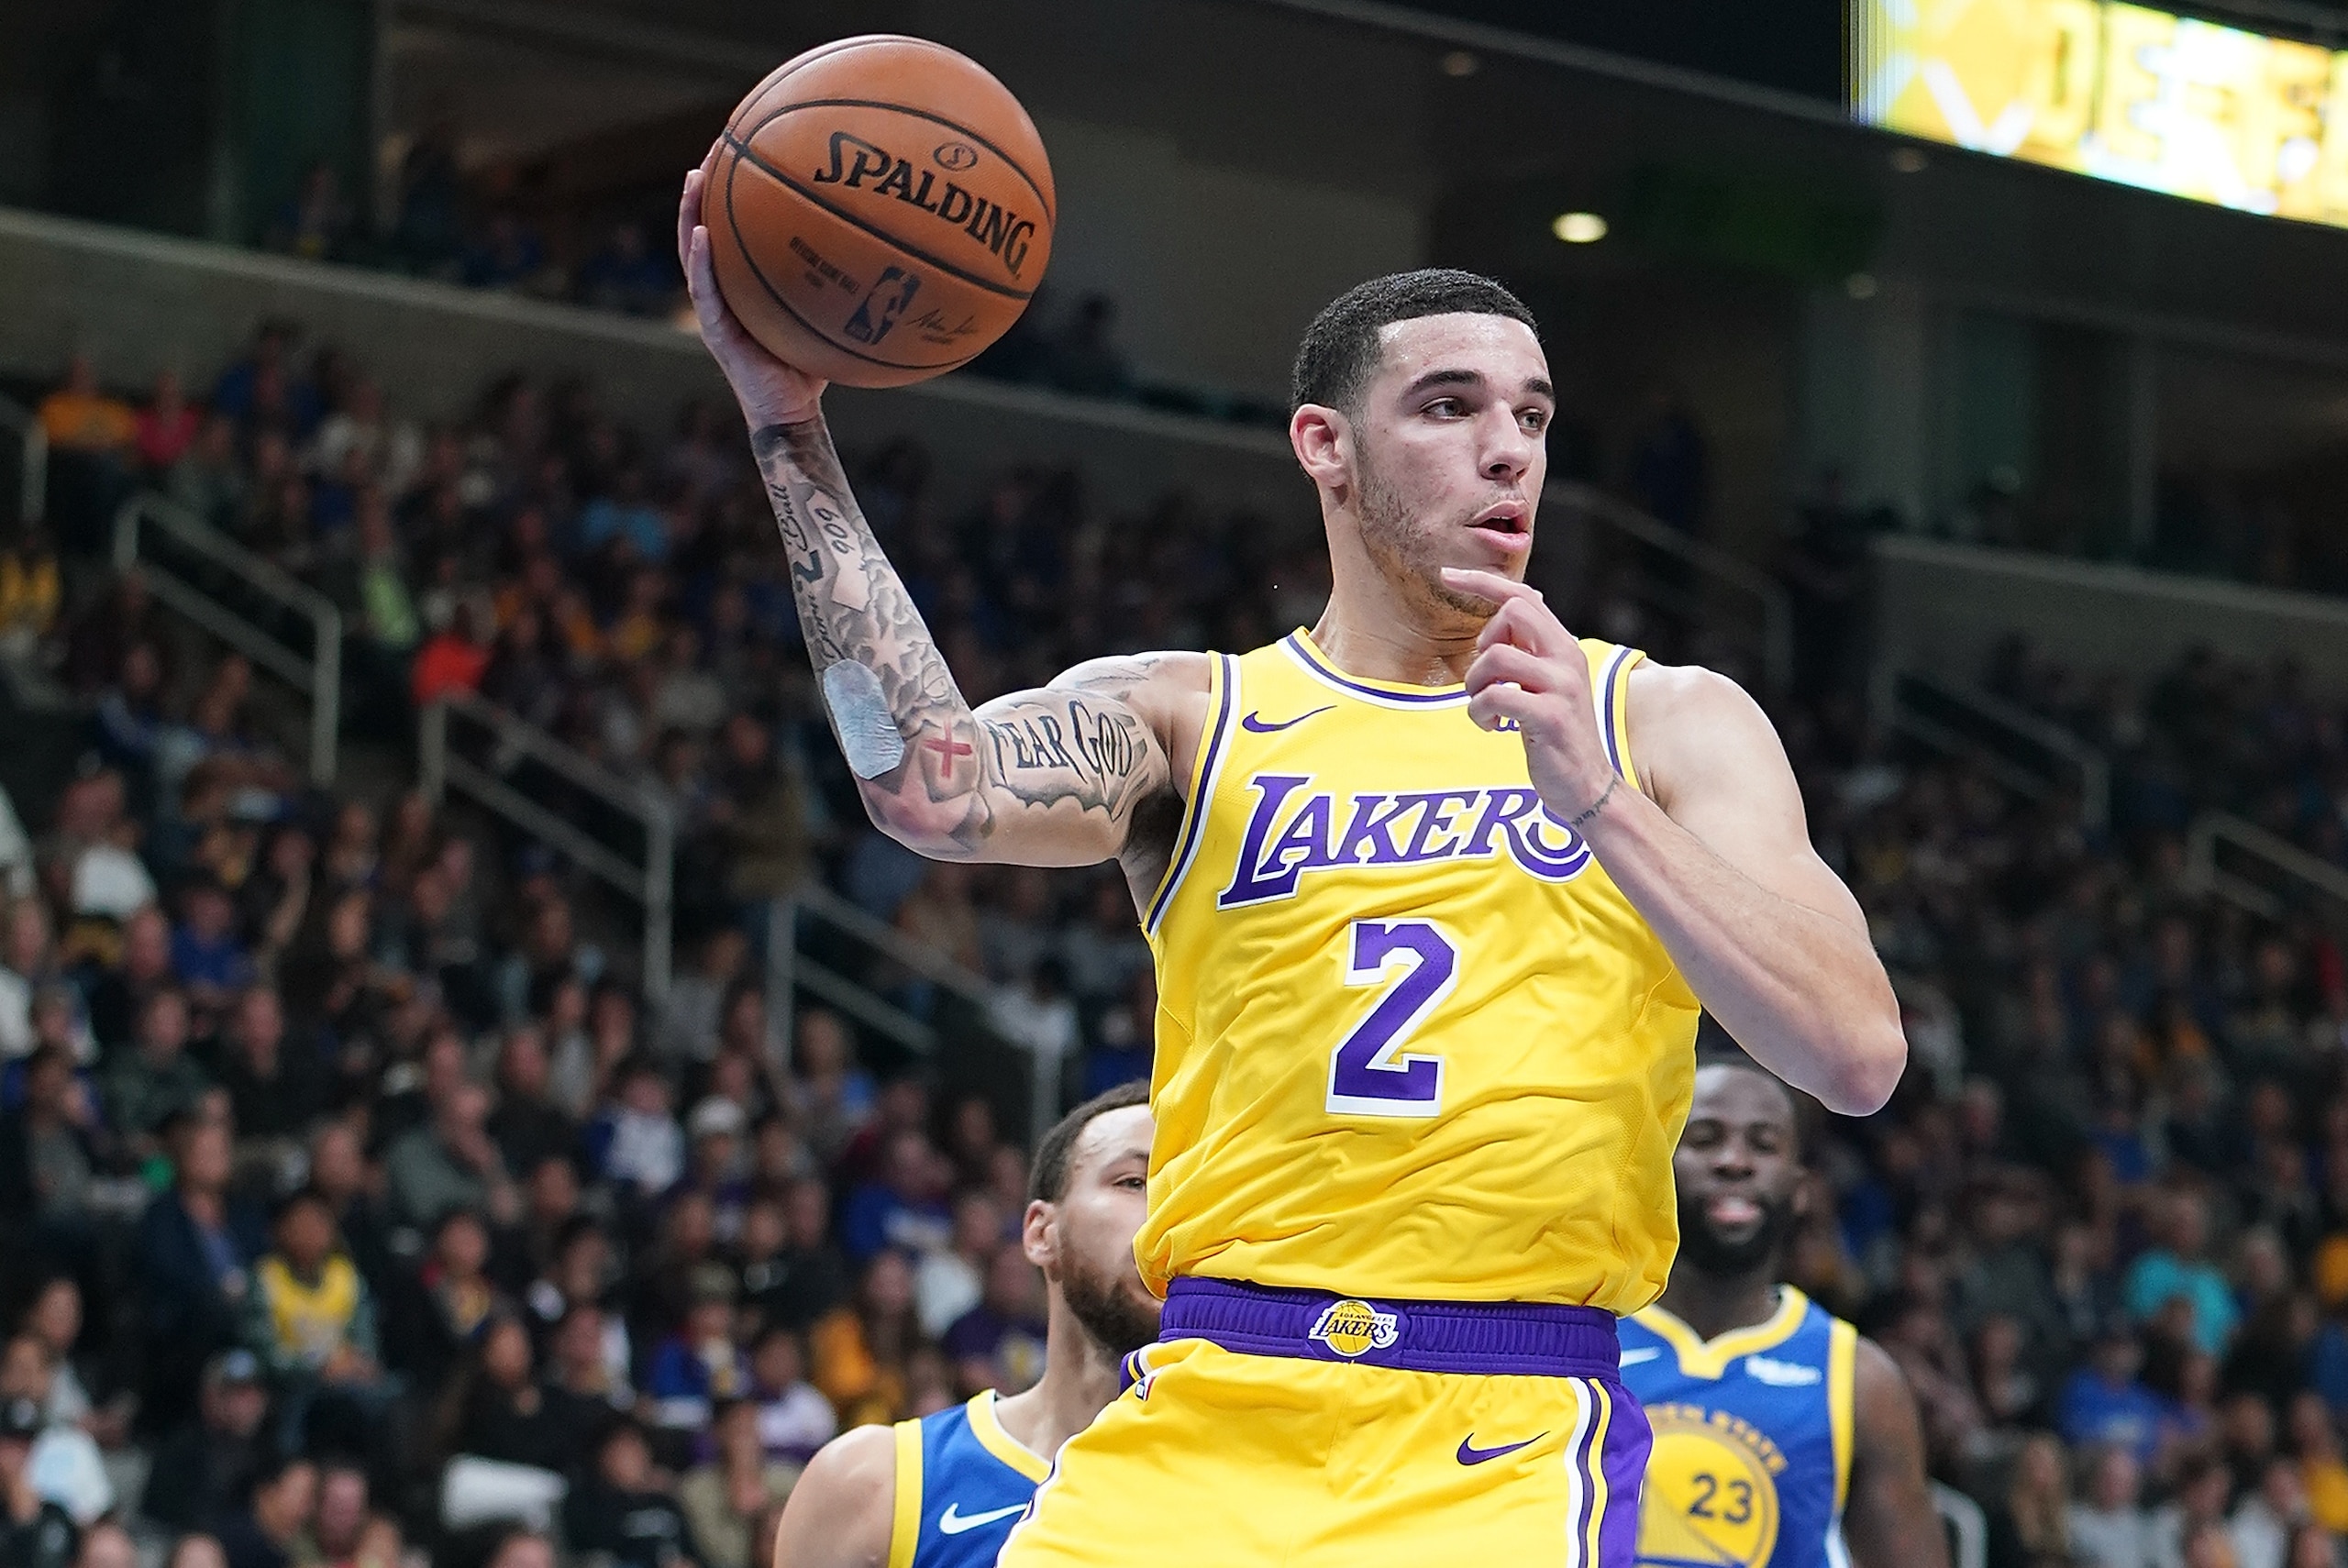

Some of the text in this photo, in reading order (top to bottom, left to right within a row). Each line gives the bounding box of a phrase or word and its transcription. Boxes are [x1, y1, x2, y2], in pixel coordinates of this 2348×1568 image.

[814, 131, 1036, 275] SPALDING
[982, 715, 1088, 786] FEAR
[1216, 772, 1594, 911] LAKERS
[1325, 918, 1460, 1117] 2
[1313, 1310, 1396, 1346] LAKERS
[1688, 1471, 1753, 1526] 23
